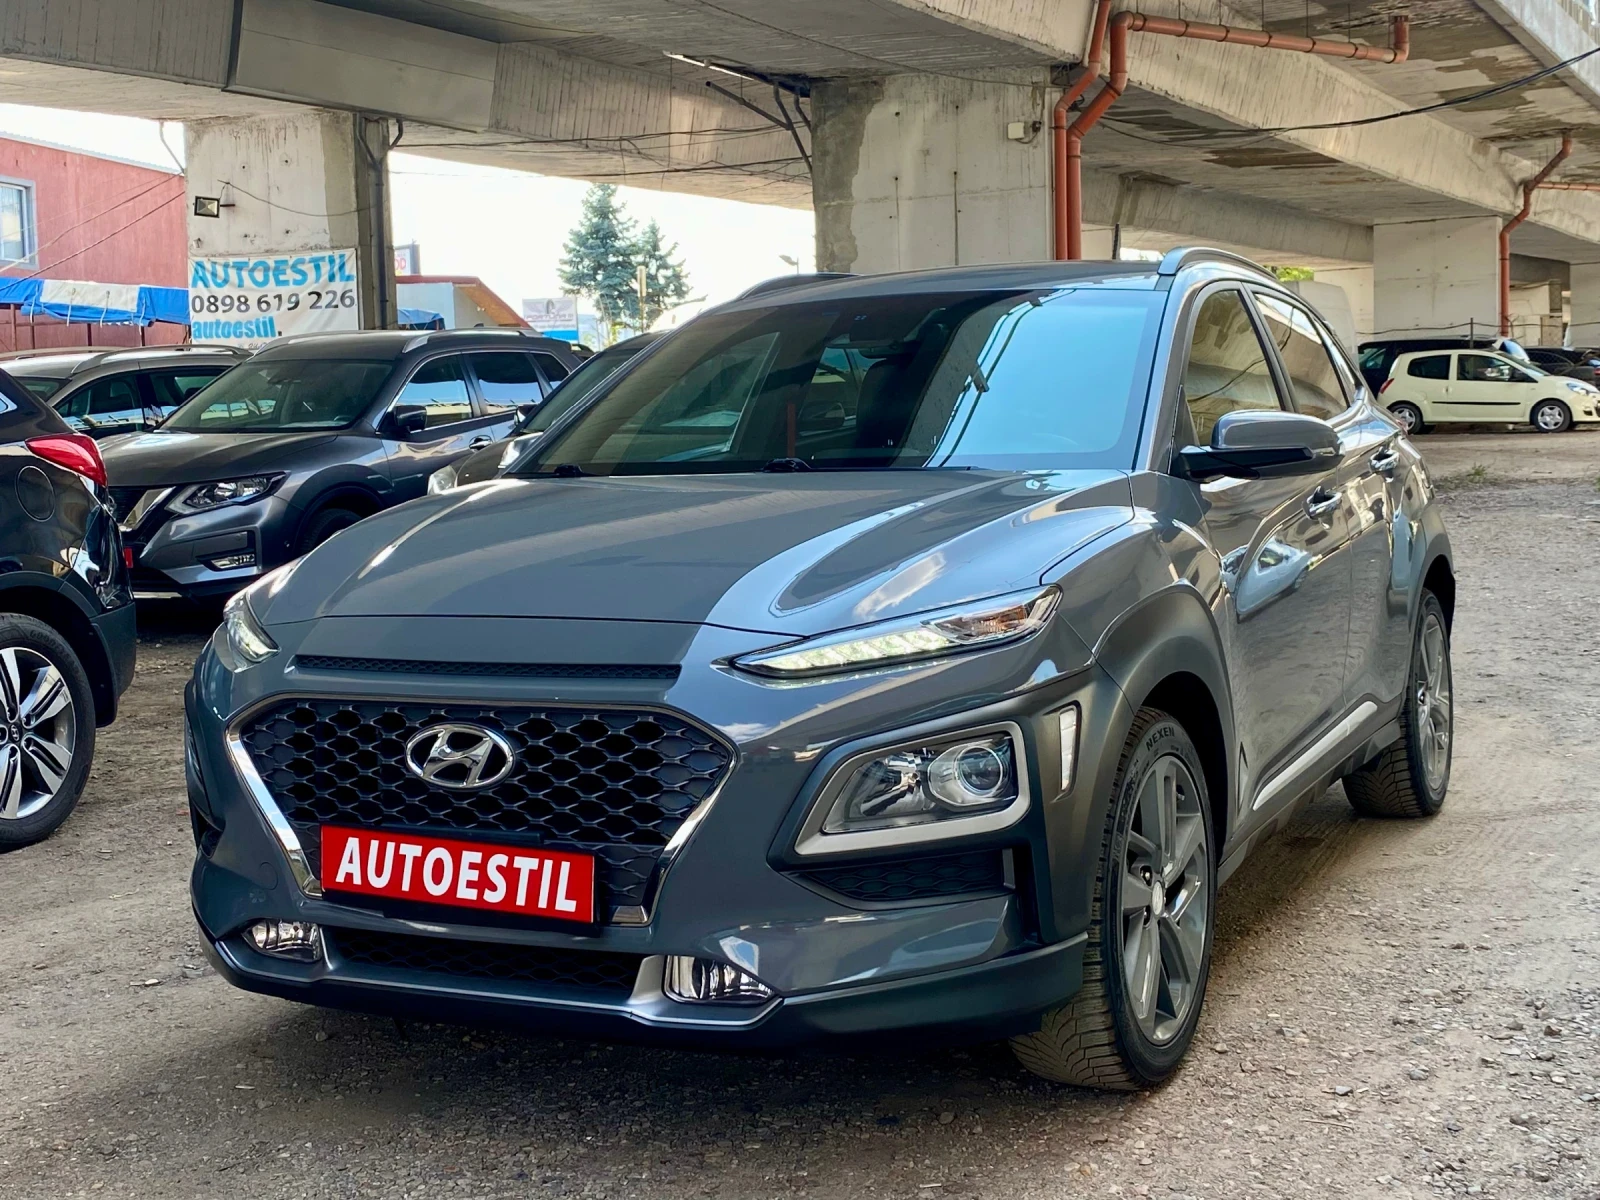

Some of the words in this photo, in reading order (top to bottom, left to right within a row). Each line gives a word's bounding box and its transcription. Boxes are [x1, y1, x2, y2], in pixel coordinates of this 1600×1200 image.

[191, 254, 354, 288] AUTOESTIL
[191, 294, 250, 313] 0898
[257, 294, 300, 312] 619
[308, 289, 355, 309] 226
[1145, 726, 1175, 751] NEXEN
[335, 836, 577, 913] AUTOESTIL
